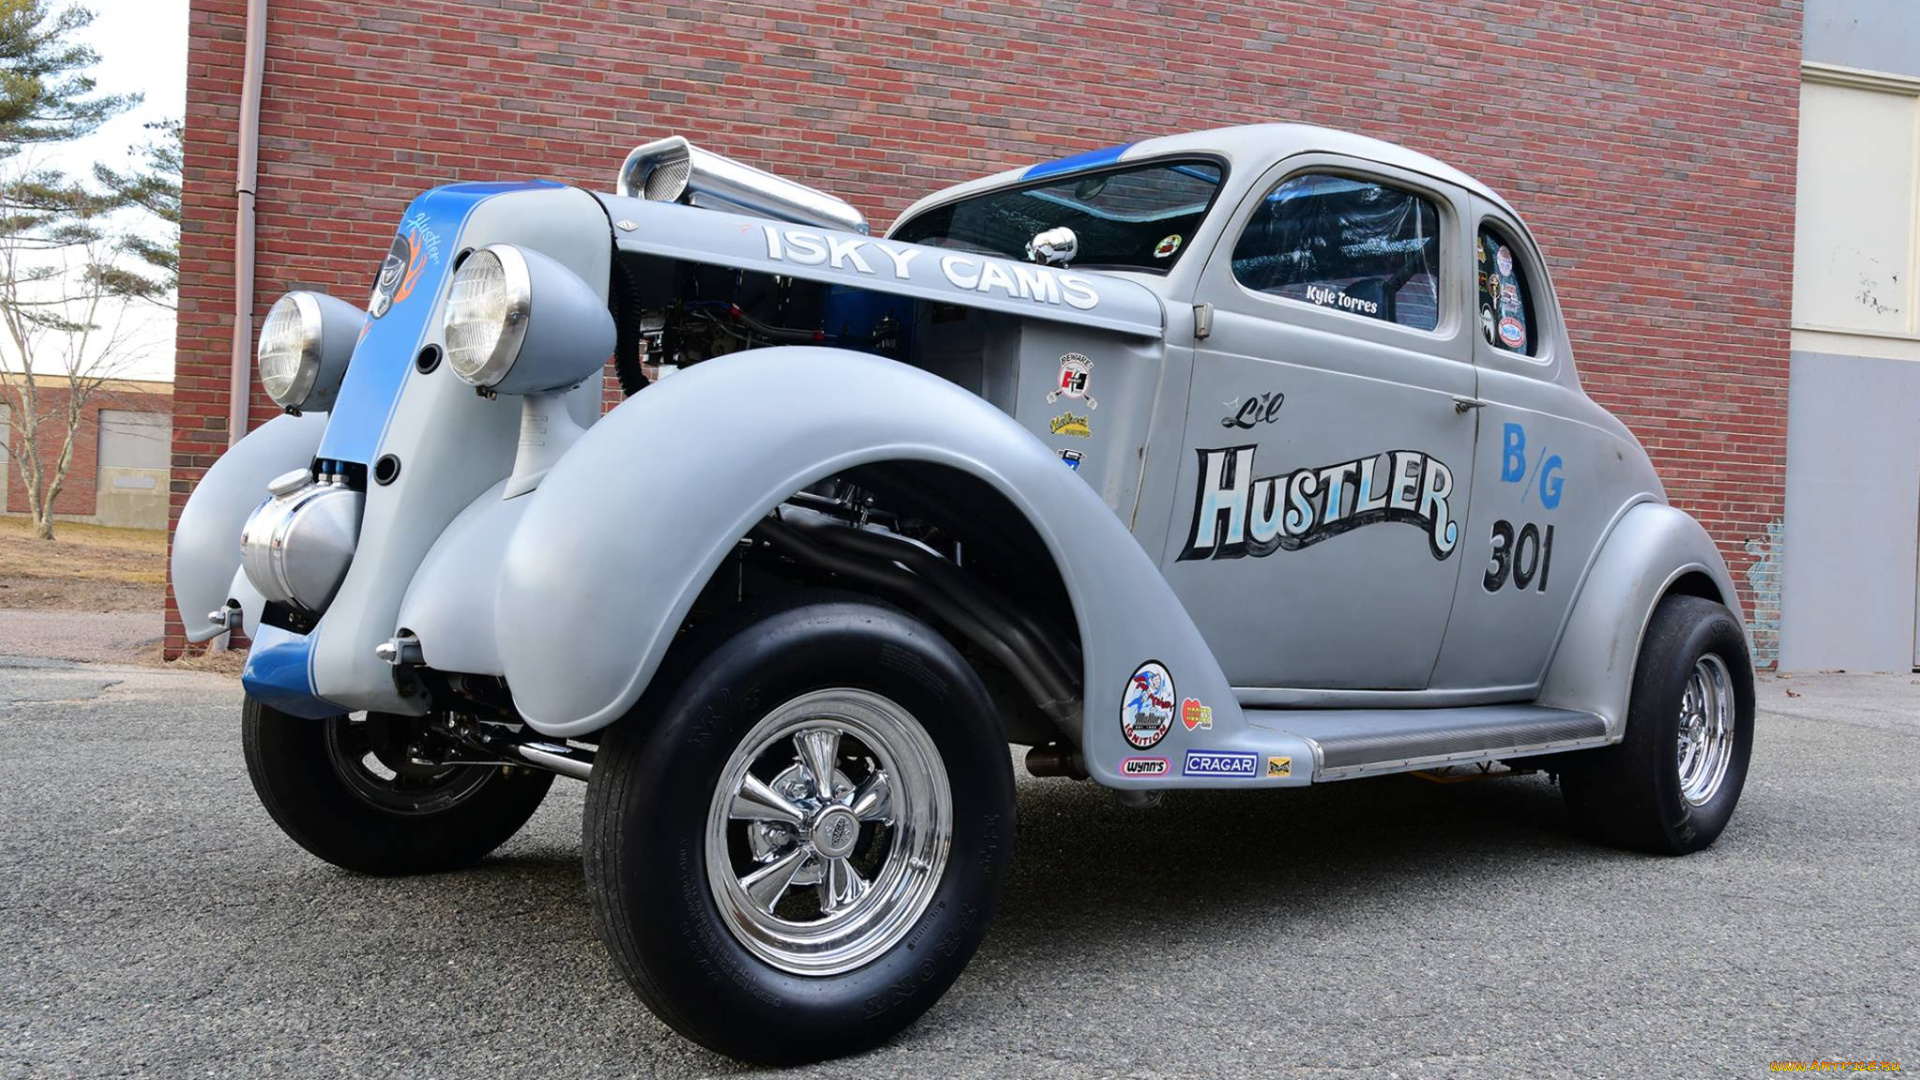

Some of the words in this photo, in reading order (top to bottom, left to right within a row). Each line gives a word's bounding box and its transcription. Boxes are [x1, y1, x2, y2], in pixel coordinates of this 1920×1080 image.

[761, 225, 922, 281] ISKY
[940, 255, 1100, 310] CAMS
[1306, 285, 1335, 307] Kyle
[1338, 290, 1378, 315] Torres
[1176, 443, 1458, 561] HUSTLER
[1481, 519, 1554, 595] 301
[1124, 723, 1167, 745] IGNITION
[1189, 757, 1253, 772] CRAGAR
